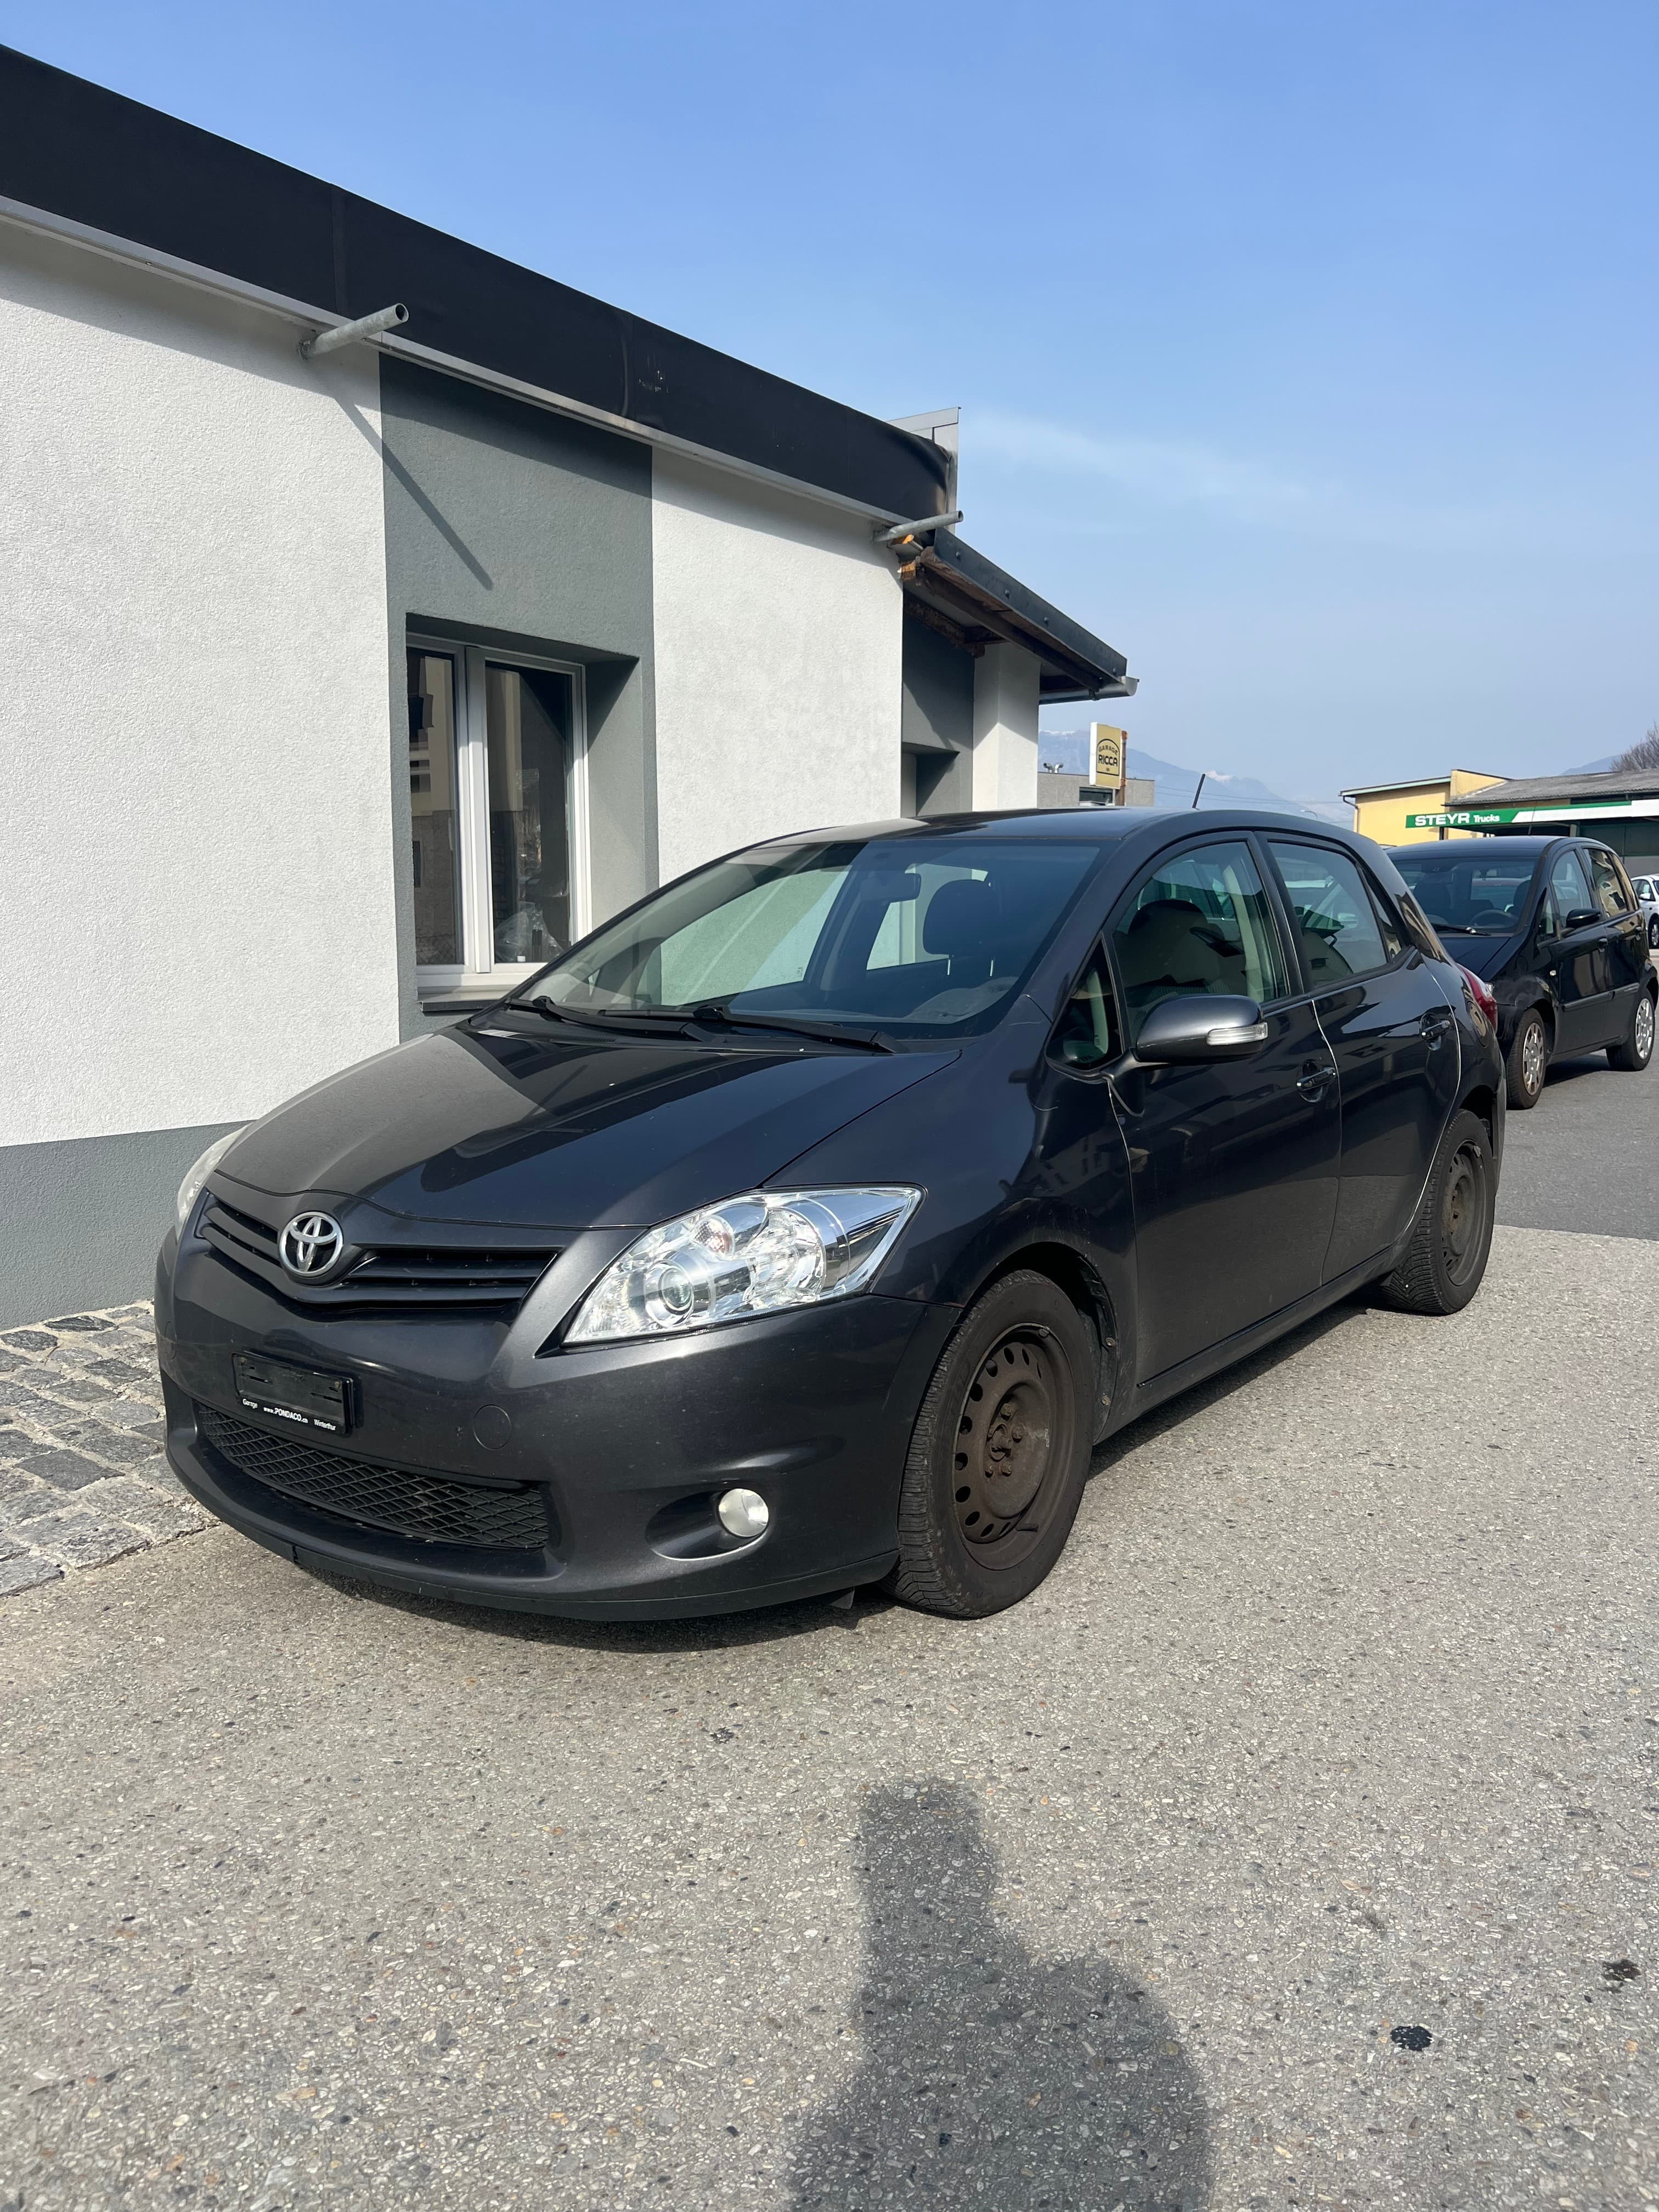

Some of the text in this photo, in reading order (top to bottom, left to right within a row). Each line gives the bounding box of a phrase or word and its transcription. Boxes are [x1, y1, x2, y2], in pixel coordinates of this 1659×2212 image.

[1098, 745, 1118, 755] GARAGE
[1098, 754, 1118, 766] RICCA
[1415, 812, 1500, 826] STEYR Trucks
[242, 1398, 258, 1409] Garage
